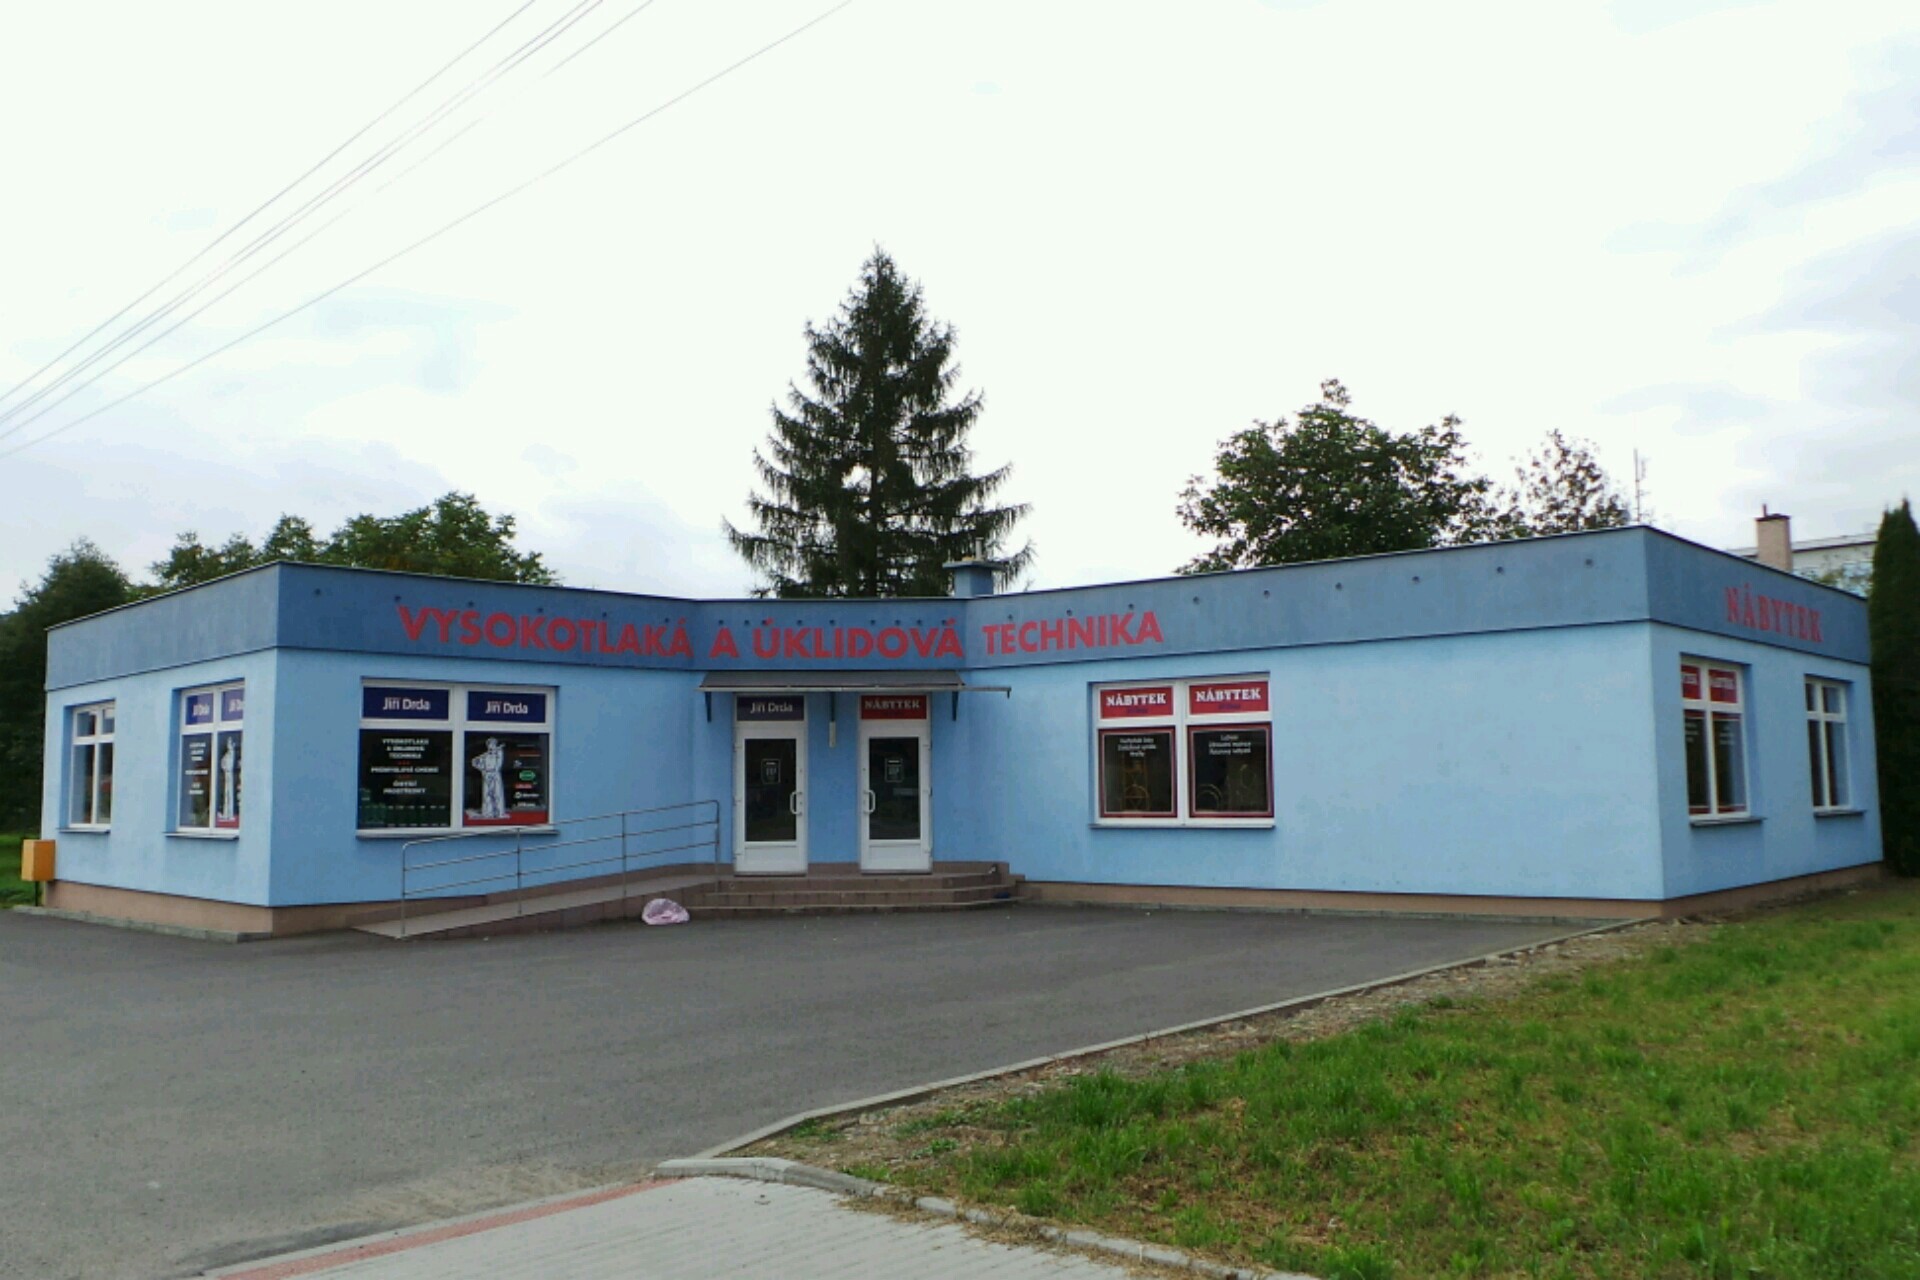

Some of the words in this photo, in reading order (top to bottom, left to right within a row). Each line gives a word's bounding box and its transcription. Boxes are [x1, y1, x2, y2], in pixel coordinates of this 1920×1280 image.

[1725, 582, 1823, 642] NÁBYTEK
[397, 606, 692, 657] VYSOKOTLAKÁ
[709, 628, 738, 658] A
[753, 618, 963, 658] ÚKLIDOVÁ
[983, 611, 1163, 655] TECHNIKA
[1106, 692, 1167, 707] NÁBYTEK
[1196, 687, 1261, 703] NÁBYTEK
[402, 699, 431, 711] Drda
[503, 702, 529, 714] Drda
[865, 699, 921, 710] NÁBYTEK
